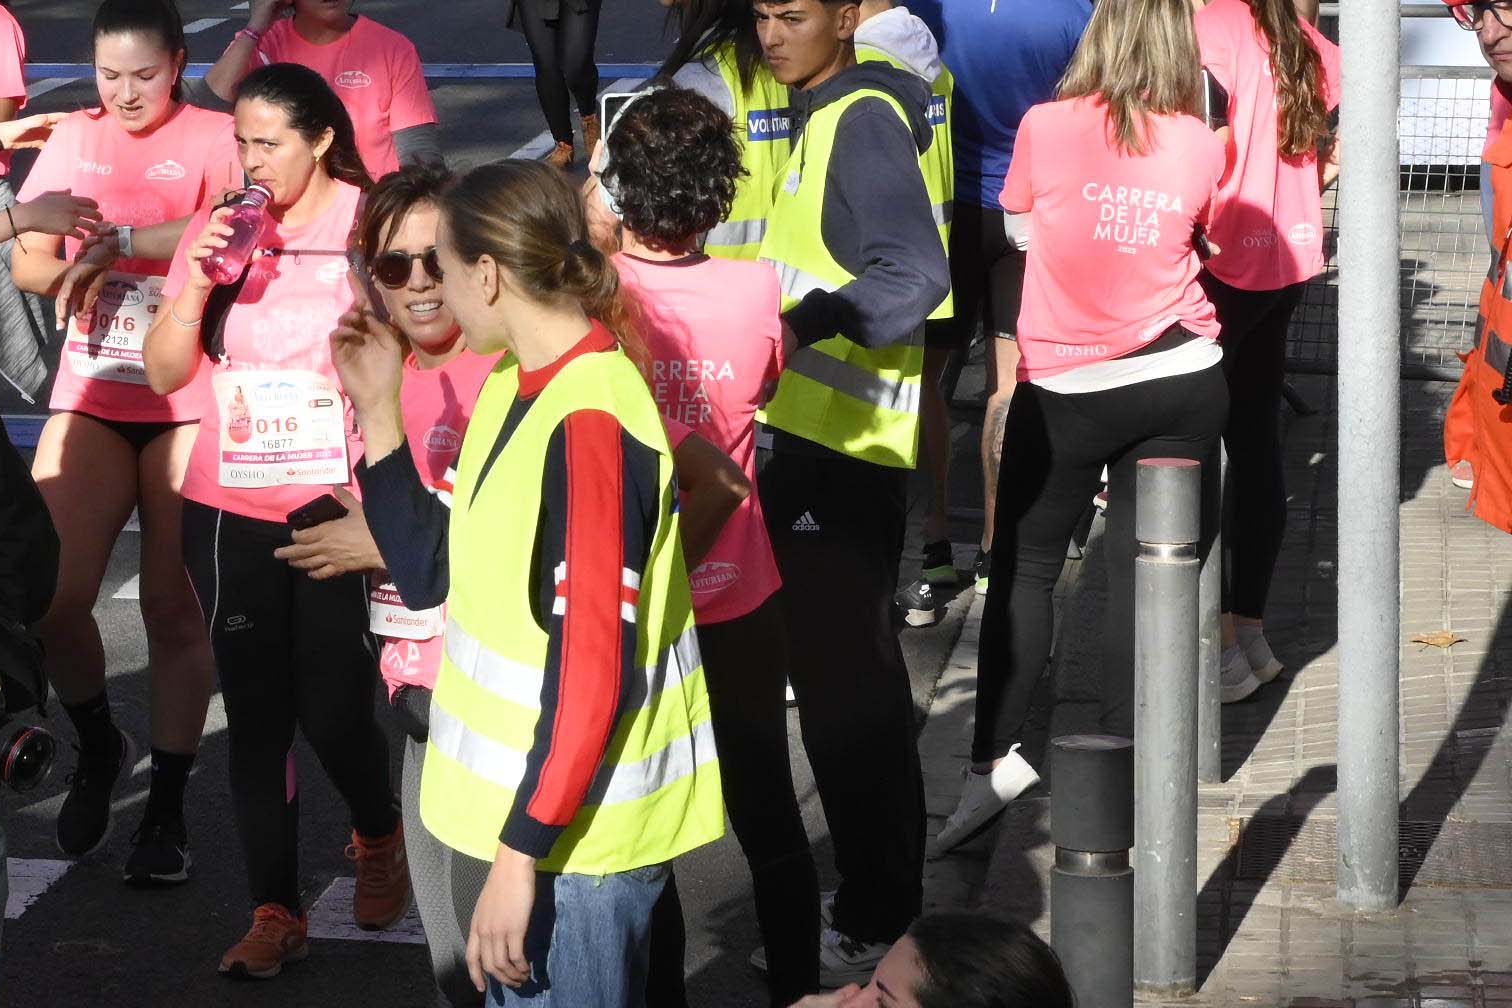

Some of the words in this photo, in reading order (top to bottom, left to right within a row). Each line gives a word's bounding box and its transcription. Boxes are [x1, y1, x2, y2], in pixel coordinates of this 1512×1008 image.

[1082, 182, 1183, 213] CARRERA
[1100, 204, 1130, 224] DE
[1135, 207, 1160, 228] LA
[1093, 224, 1160, 247] MUJER
[99, 313, 135, 331] 016
[1055, 343, 1108, 357] OYSHO
[679, 382, 709, 403] LA
[256, 416, 298, 433] 016
[262, 438, 293, 449] 16877
[232, 453, 263, 463] CARRERA
[264, 453, 275, 461] DE
[276, 452, 286, 461] LA
[230, 469, 265, 480] OYSHO
[792, 523, 820, 532] adidas
[394, 614, 427, 626] Santander
